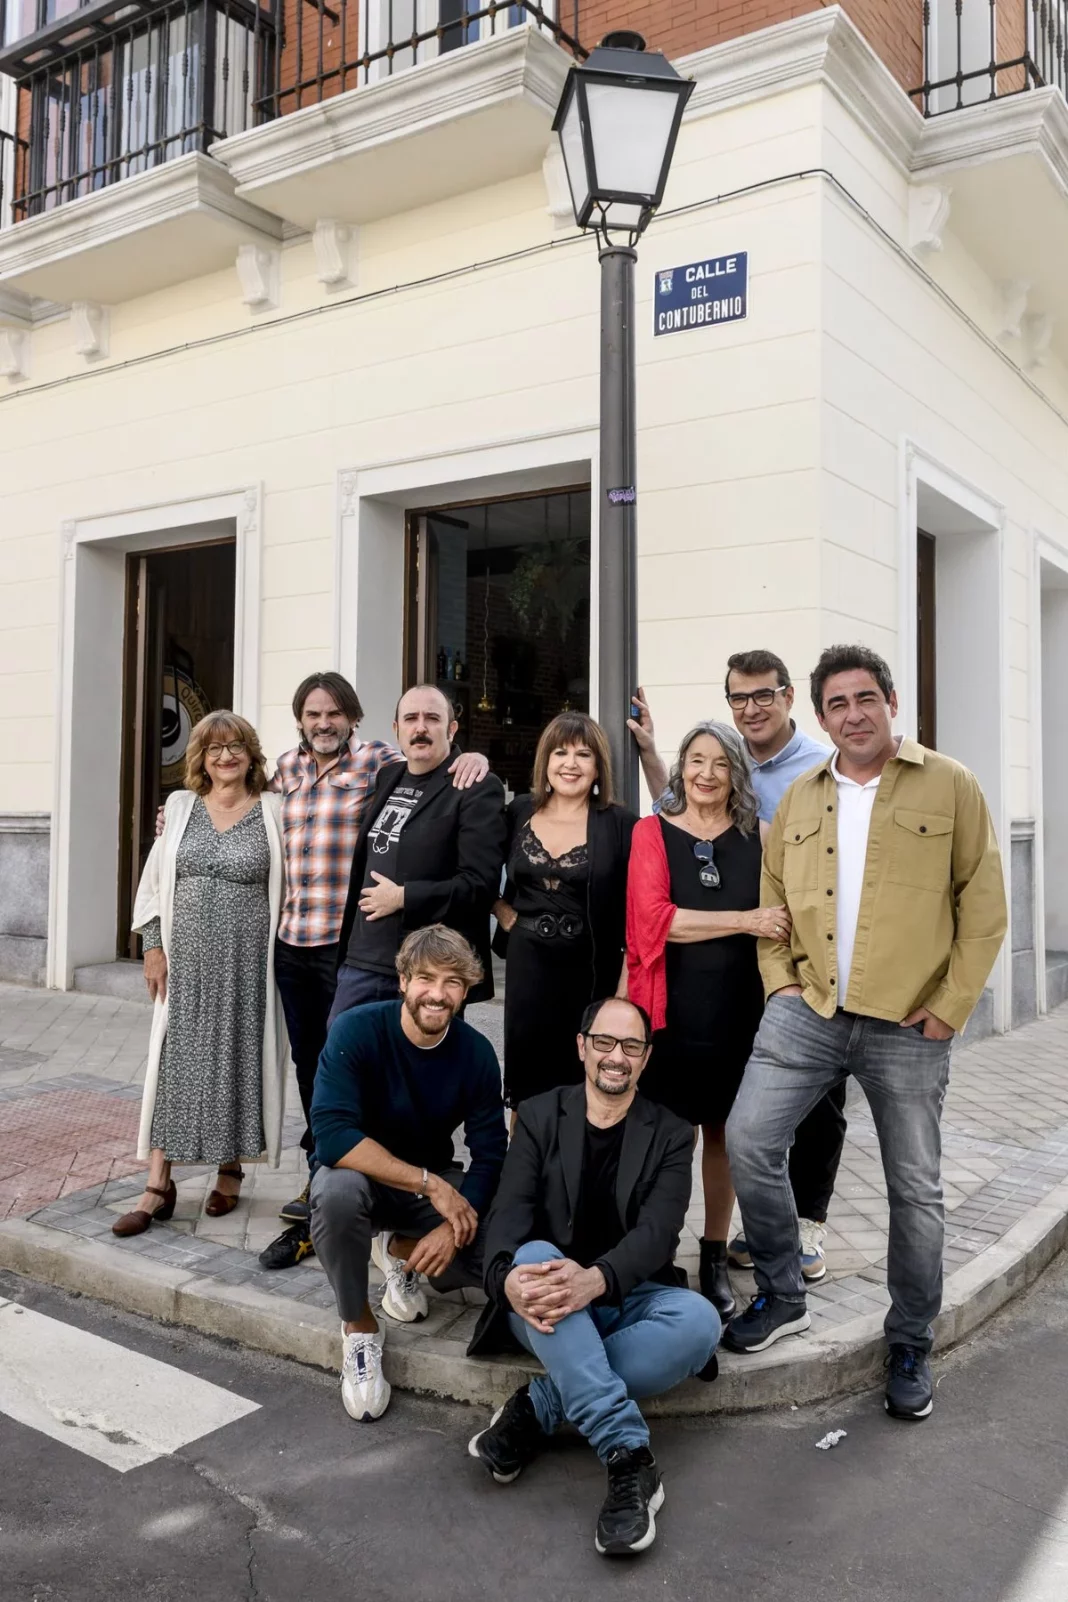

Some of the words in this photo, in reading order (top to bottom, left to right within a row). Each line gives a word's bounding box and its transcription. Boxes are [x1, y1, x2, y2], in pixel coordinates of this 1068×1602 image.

[685, 257, 737, 283] CALLE
[691, 285, 708, 299] DEL
[658, 296, 742, 331] CONTUBERNIO
